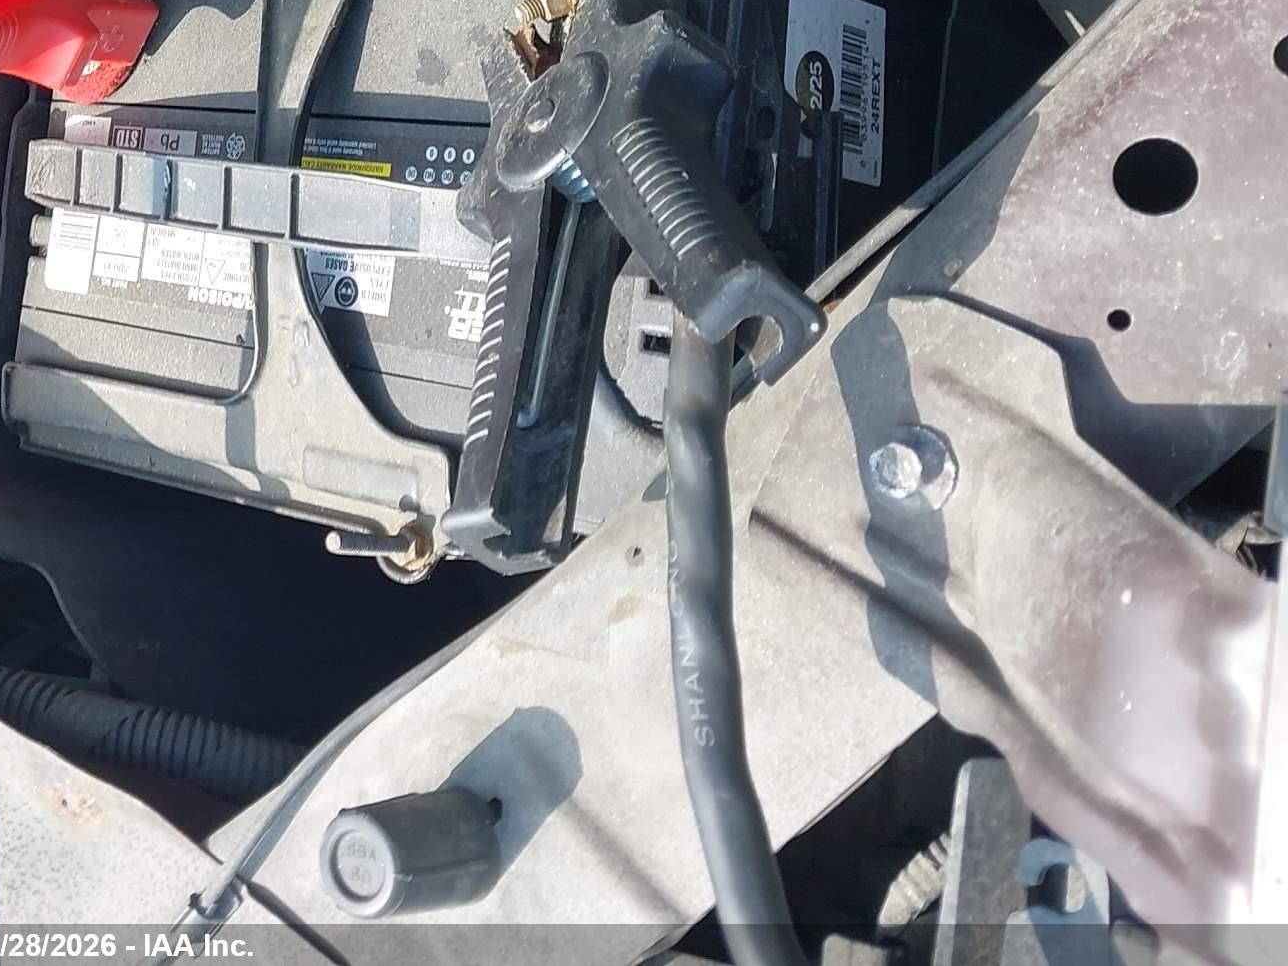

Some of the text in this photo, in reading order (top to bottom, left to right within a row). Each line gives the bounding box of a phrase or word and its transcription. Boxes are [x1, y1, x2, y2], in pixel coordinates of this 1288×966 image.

[871, 57, 881, 134] 24REXT
[117, 129, 139, 149] STD
[160, 134, 181, 151] Pb
[325, 258, 349, 272] GASES
